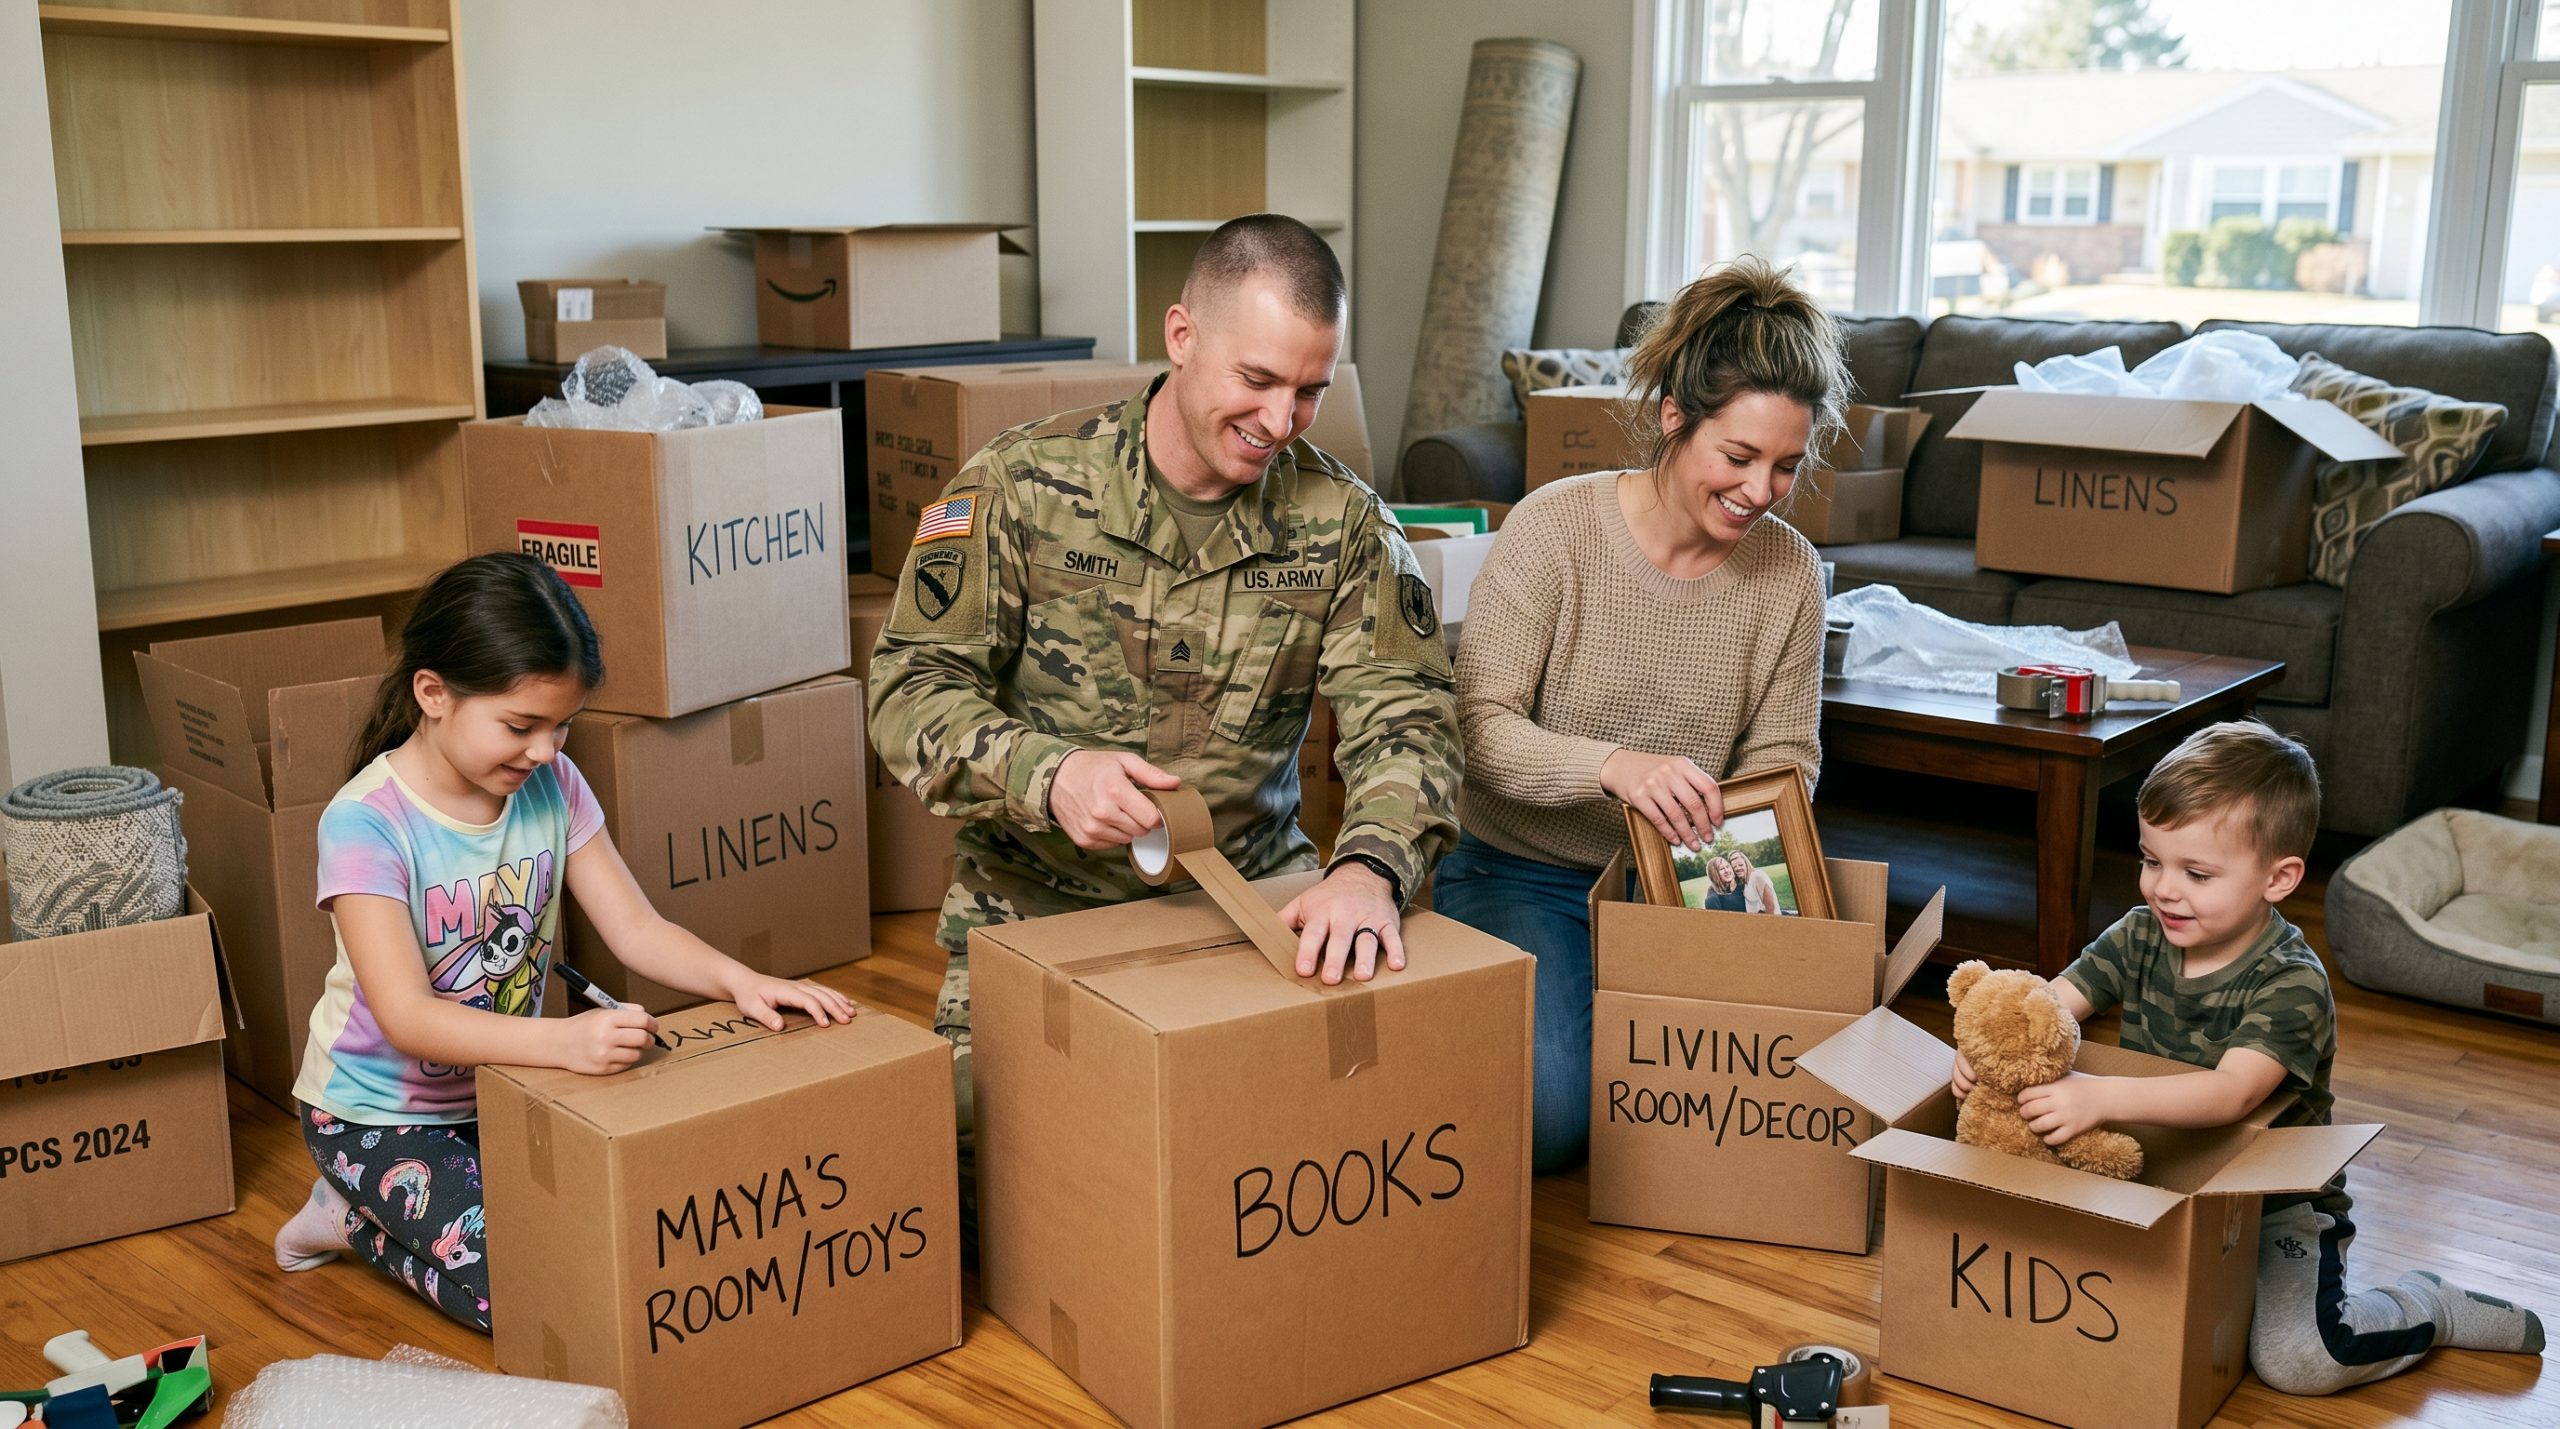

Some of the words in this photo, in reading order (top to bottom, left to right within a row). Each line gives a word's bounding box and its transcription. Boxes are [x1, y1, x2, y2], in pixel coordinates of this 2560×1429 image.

[2034, 467, 2178, 516] LINENS
[521, 538, 598, 569] FRAGILE
[687, 501, 824, 586] KITCHEN
[1064, 550, 1119, 578] SMITH
[667, 799, 838, 890] LINENS
[1629, 1019, 1799, 1079] LIVING
[0, 1137, 62, 1178] PCS
[73, 1119, 151, 1164] 2024
[1608, 1080, 1858, 1147] ROOM/DECOR
[656, 1153, 847, 1269] MAYA'S
[1233, 1122, 1465, 1258] BOOKS
[645, 1206, 927, 1354] ROOM/TOYS
[1951, 1232, 2119, 1342] KIDS
